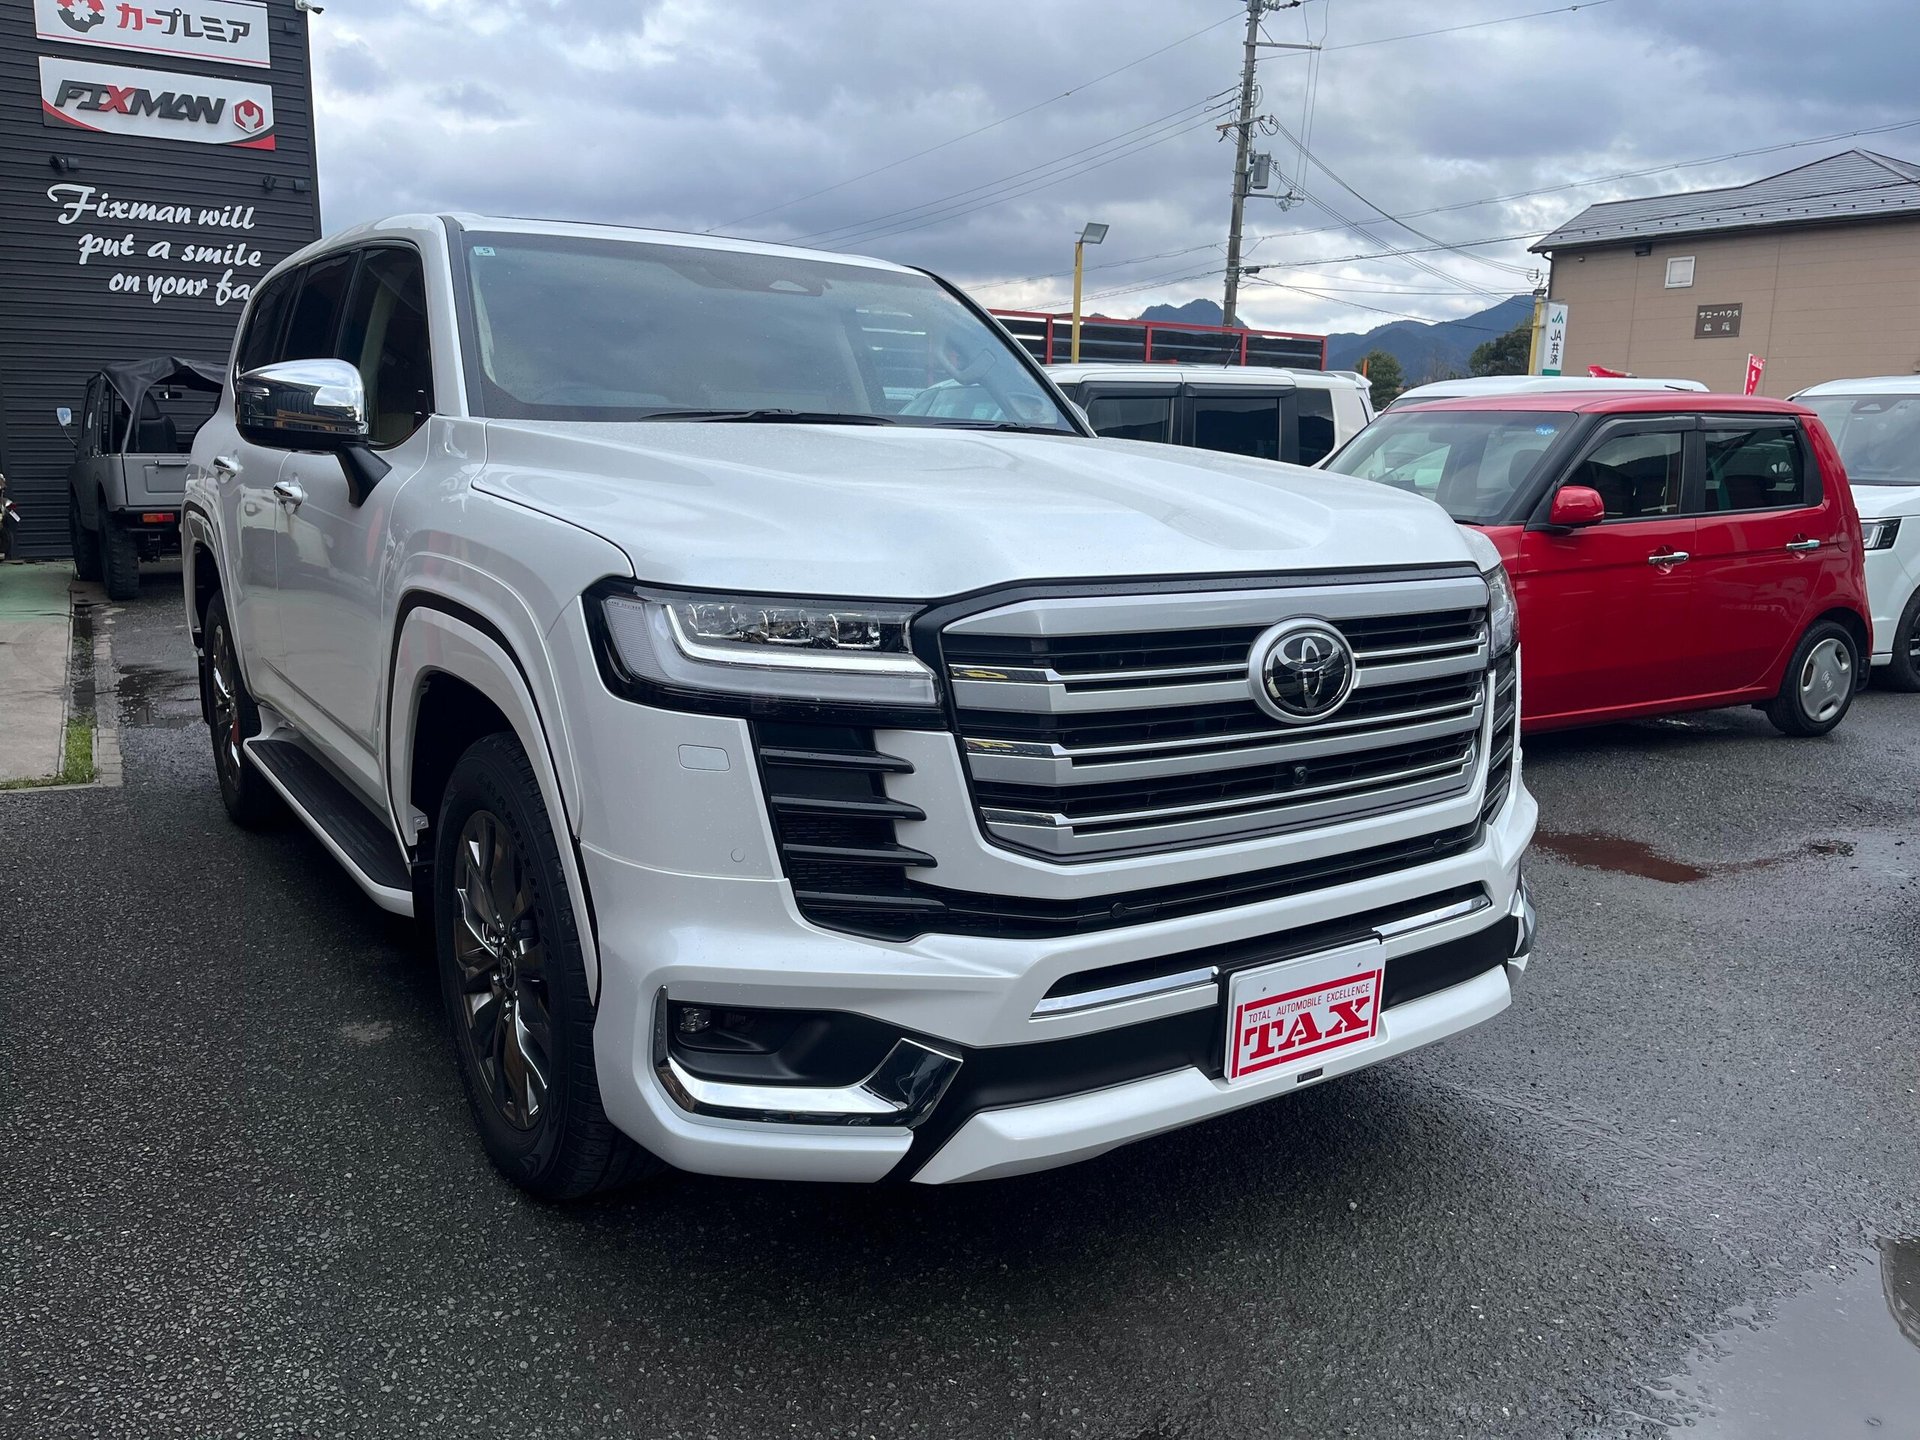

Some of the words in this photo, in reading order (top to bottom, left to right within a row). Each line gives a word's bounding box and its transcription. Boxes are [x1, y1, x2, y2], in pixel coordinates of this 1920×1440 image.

[116, 4, 251, 43] カープレミア
[54, 79, 226, 124] FIXMAN
[47, 184, 191, 224] Fixman
[198, 205, 255, 229] will
[78, 233, 135, 265] put
[147, 241, 171, 260] a
[181, 243, 262, 267] smile
[108, 273, 140, 293] on
[147, 275, 208, 304] your
[216, 269, 252, 306] fa
[1248, 1010, 1271, 1024] TOTAL
[1275, 996, 1322, 1016] AUTOMOBILE
[1326, 983, 1370, 1002] EXCELLENCE
[1243, 996, 1370, 1060] TAX
